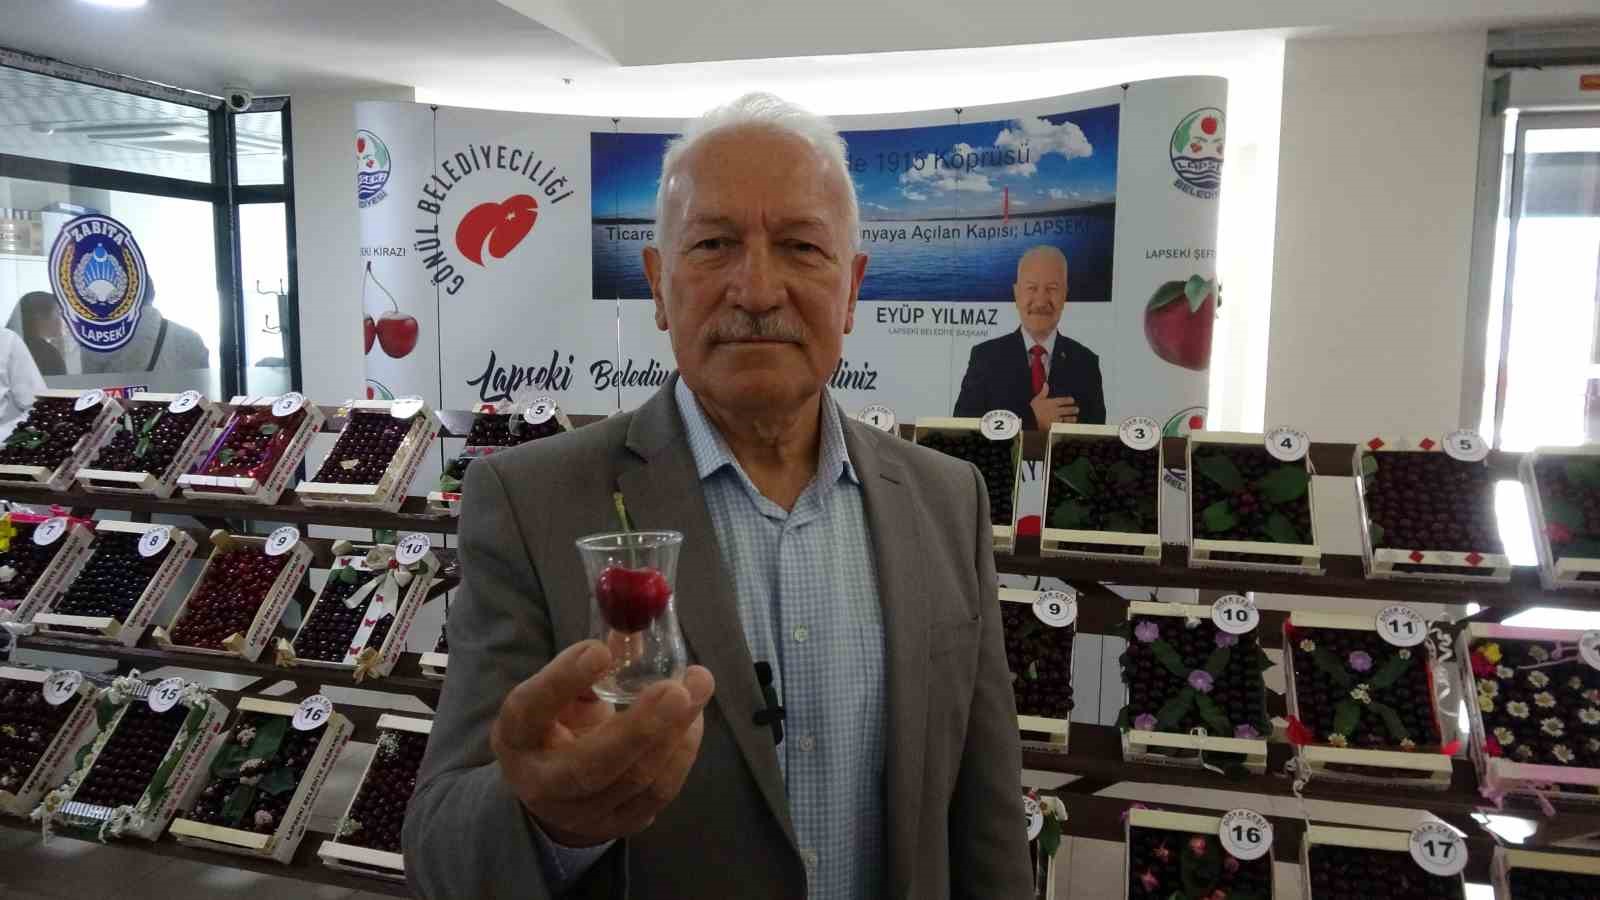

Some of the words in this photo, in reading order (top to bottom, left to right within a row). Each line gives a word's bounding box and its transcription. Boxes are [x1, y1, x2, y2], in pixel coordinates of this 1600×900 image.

[417, 144, 574, 215] BELEDİYECİLİĞİ
[72, 221, 125, 245] ZABITA
[605, 226, 655, 241] Ticare
[862, 228, 906, 242] nyaya
[912, 225, 960, 242] Açılan
[373, 247, 406, 256] KIRAZI
[414, 224, 465, 295] GÖNÜL
[877, 303, 924, 323] EYÜP
[932, 307, 998, 325] YILMAZ
[81, 323, 127, 342] LAPSEKİ
[466, 350, 575, 403] Lapseki
[589, 358, 671, 391] Belediy
[181, 398, 190, 407] 2
[535, 405, 546, 415] 5
[994, 419, 1006, 431] 2
[1134, 428, 1146, 440] 3
[1280, 437, 1293, 450] 4
[1459, 439, 1473, 450] 5
[47, 526, 56, 536] 7
[149, 535, 159, 546] 8
[276, 536, 288, 547] 9
[405, 543, 423, 554] 10
[1049, 603, 1061, 616] 9
[1223, 608, 1249, 622] 10
[1388, 619, 1414, 635] 11
[54, 680, 74, 693] 14
[160, 688, 178, 700] 15
[304, 707, 323, 721] 16
[1232, 825, 1261, 844] 16
[1423, 839, 1454, 858] 17
